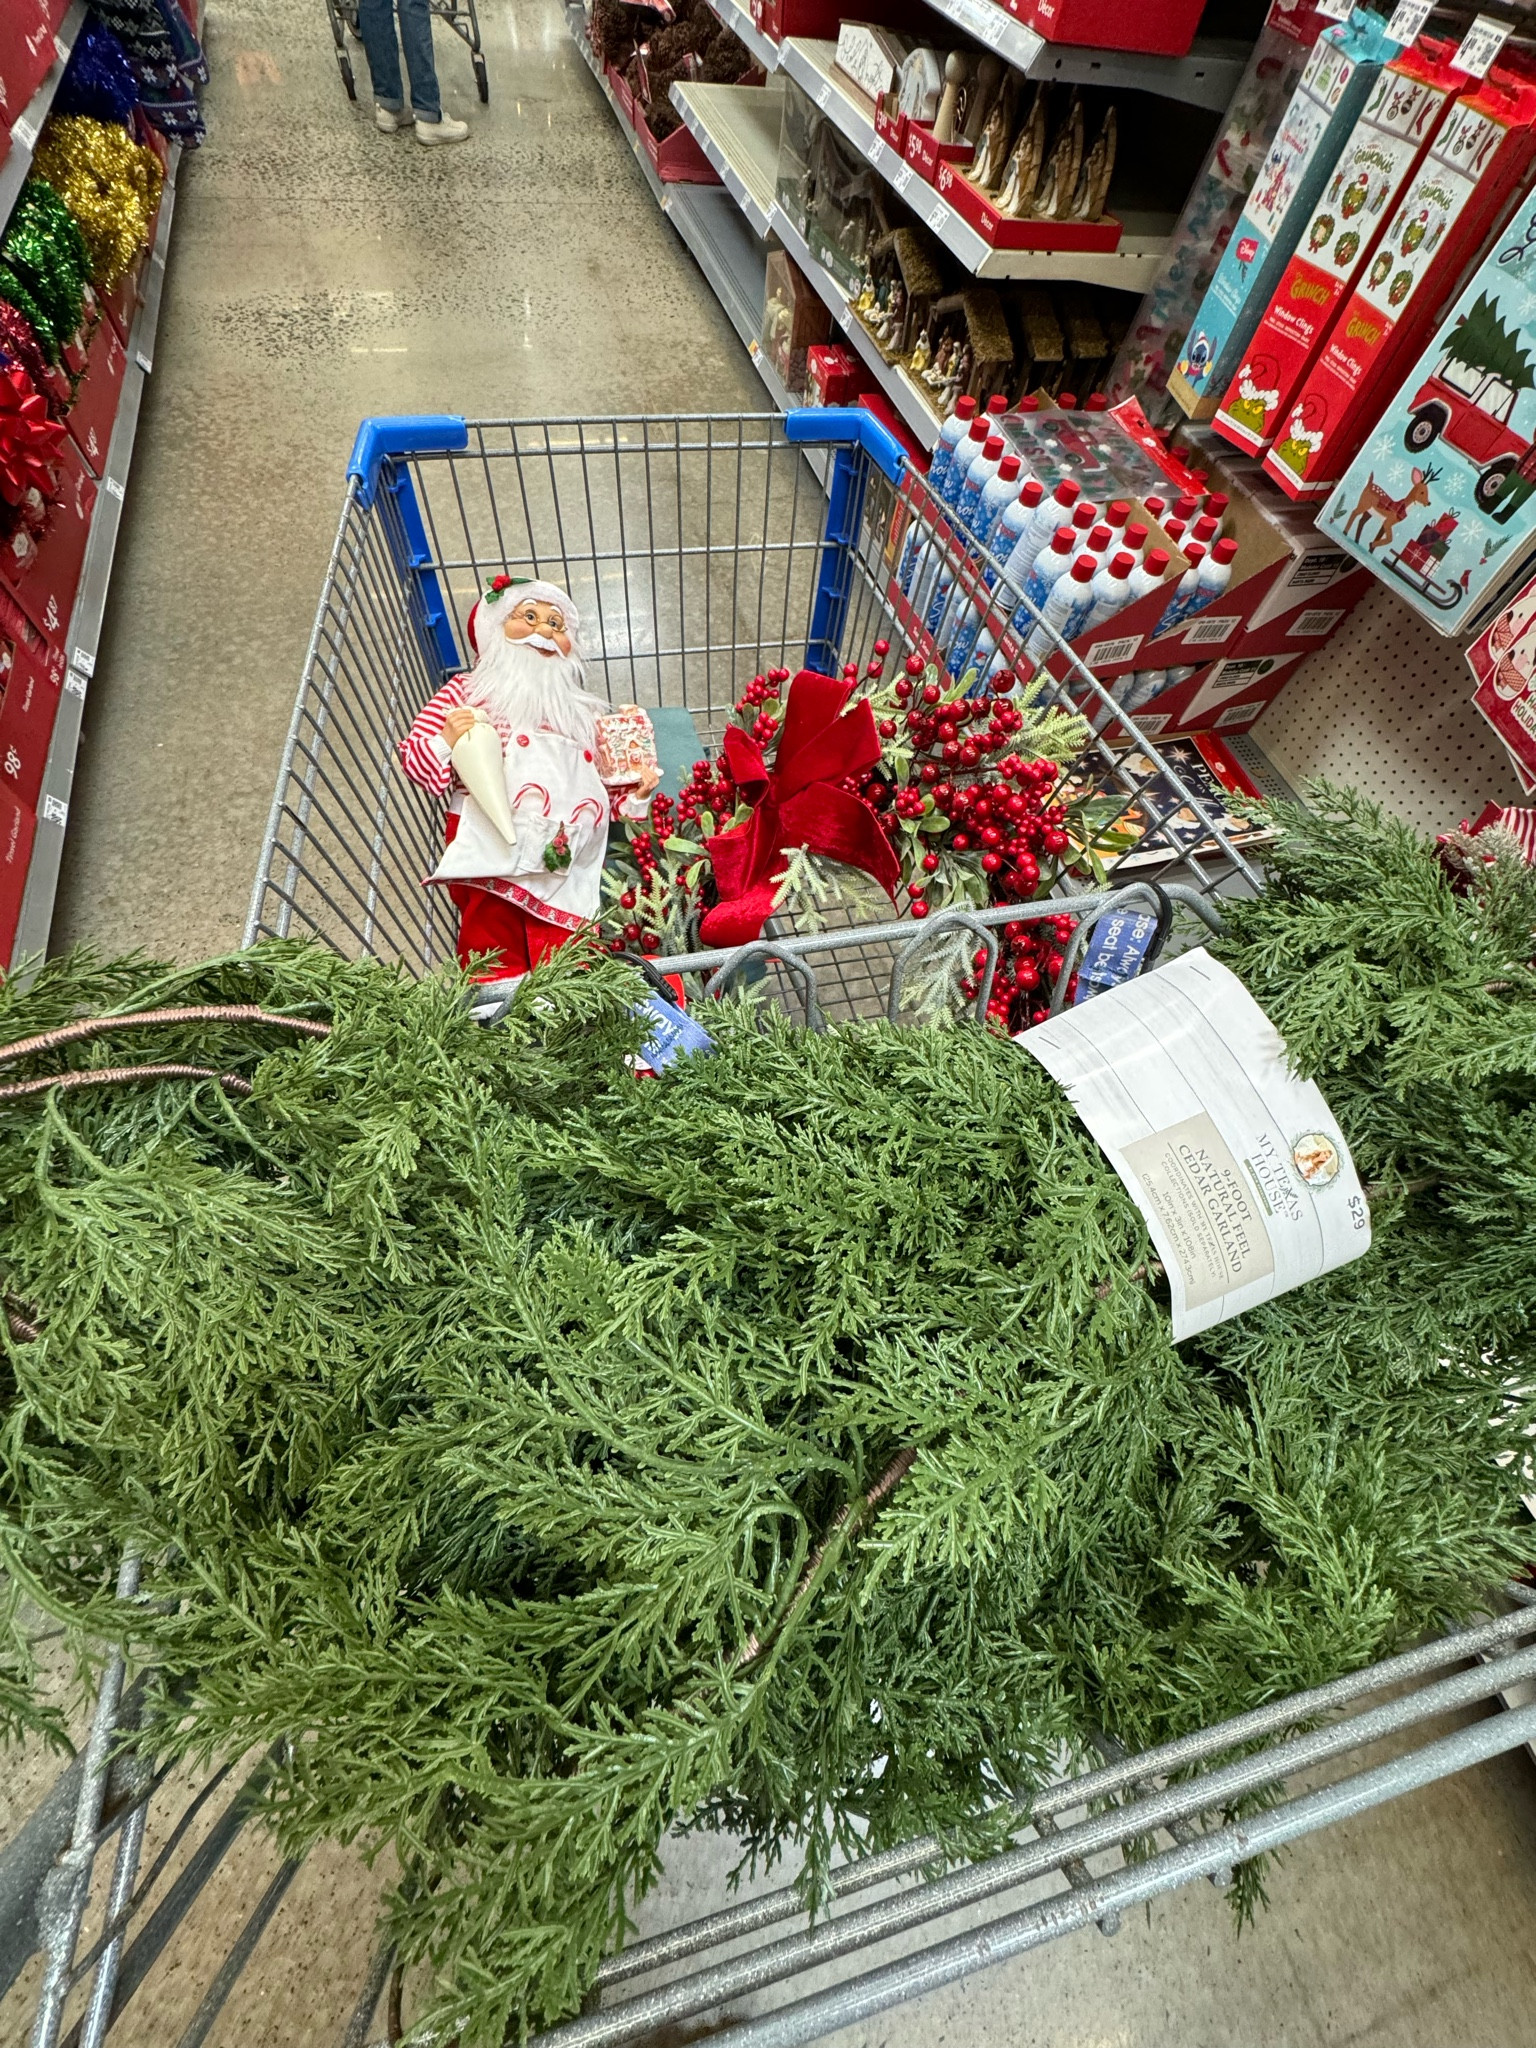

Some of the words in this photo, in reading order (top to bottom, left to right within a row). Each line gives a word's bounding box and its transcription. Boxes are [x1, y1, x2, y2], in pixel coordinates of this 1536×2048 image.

[1287, 278, 1332, 307] GRINCH
[1272, 303, 1297, 324] Window
[1293, 315, 1315, 337] Clings
[1343, 316, 1383, 345] GRINCH
[1327, 342, 1348, 363] Window
[1344, 355, 1362, 377] Clings
[1101, 918, 1125, 951] seat
[1163, 1151, 1194, 1200] COORDINATES
[1254, 1132, 1279, 1162] MY
[1270, 1162, 1305, 1222] TEXAS
[1176, 1142, 1212, 1196] CEDAR
[1206, 1196, 1244, 1274] GARLAND
[1194, 1148, 1239, 1222] NATURAL
[1231, 1222, 1253, 1259] FEEL
[1219, 1168, 1253, 1223] 9-FOOT
[1345, 1193, 1366, 1230] $29
